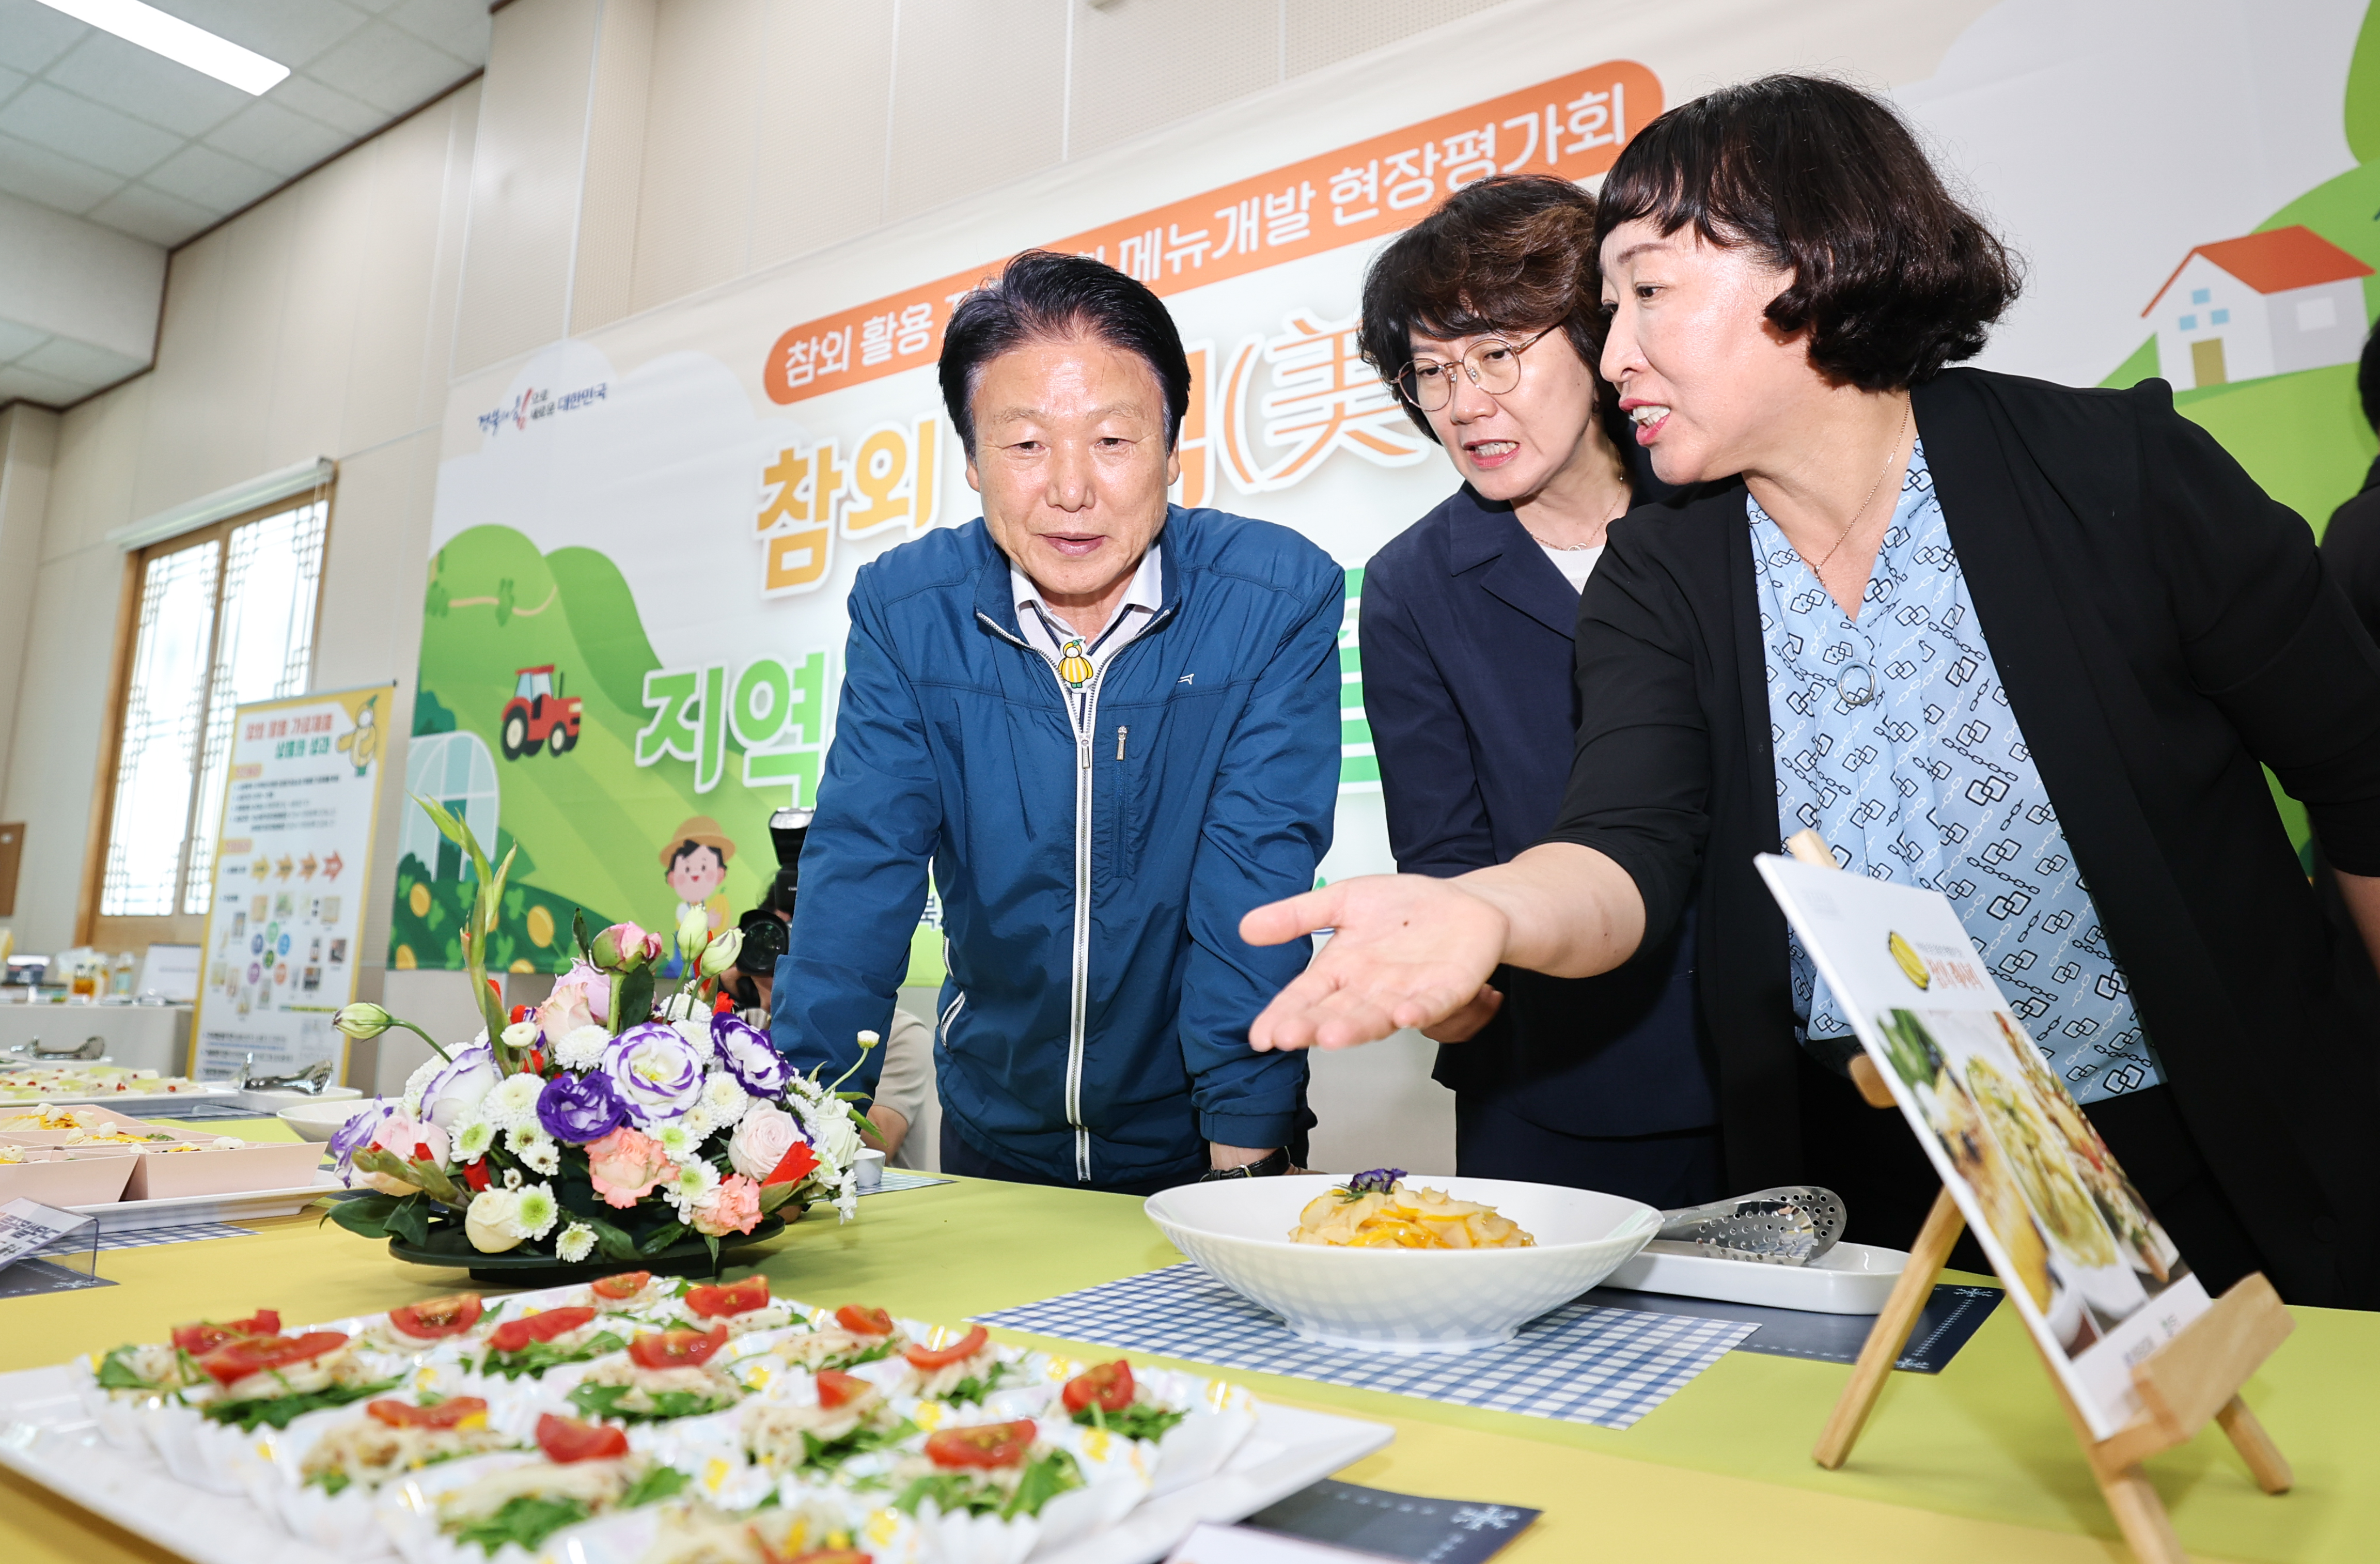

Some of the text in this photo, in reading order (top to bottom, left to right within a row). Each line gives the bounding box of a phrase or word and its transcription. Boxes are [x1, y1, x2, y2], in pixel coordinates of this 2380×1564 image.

[1119, 82, 1626, 283] 메뉴개발 현장평가회
[557, 383, 607, 411] 대한민국
[785, 301, 934, 388] 참외 활용
[755, 417, 937, 592] 참외
